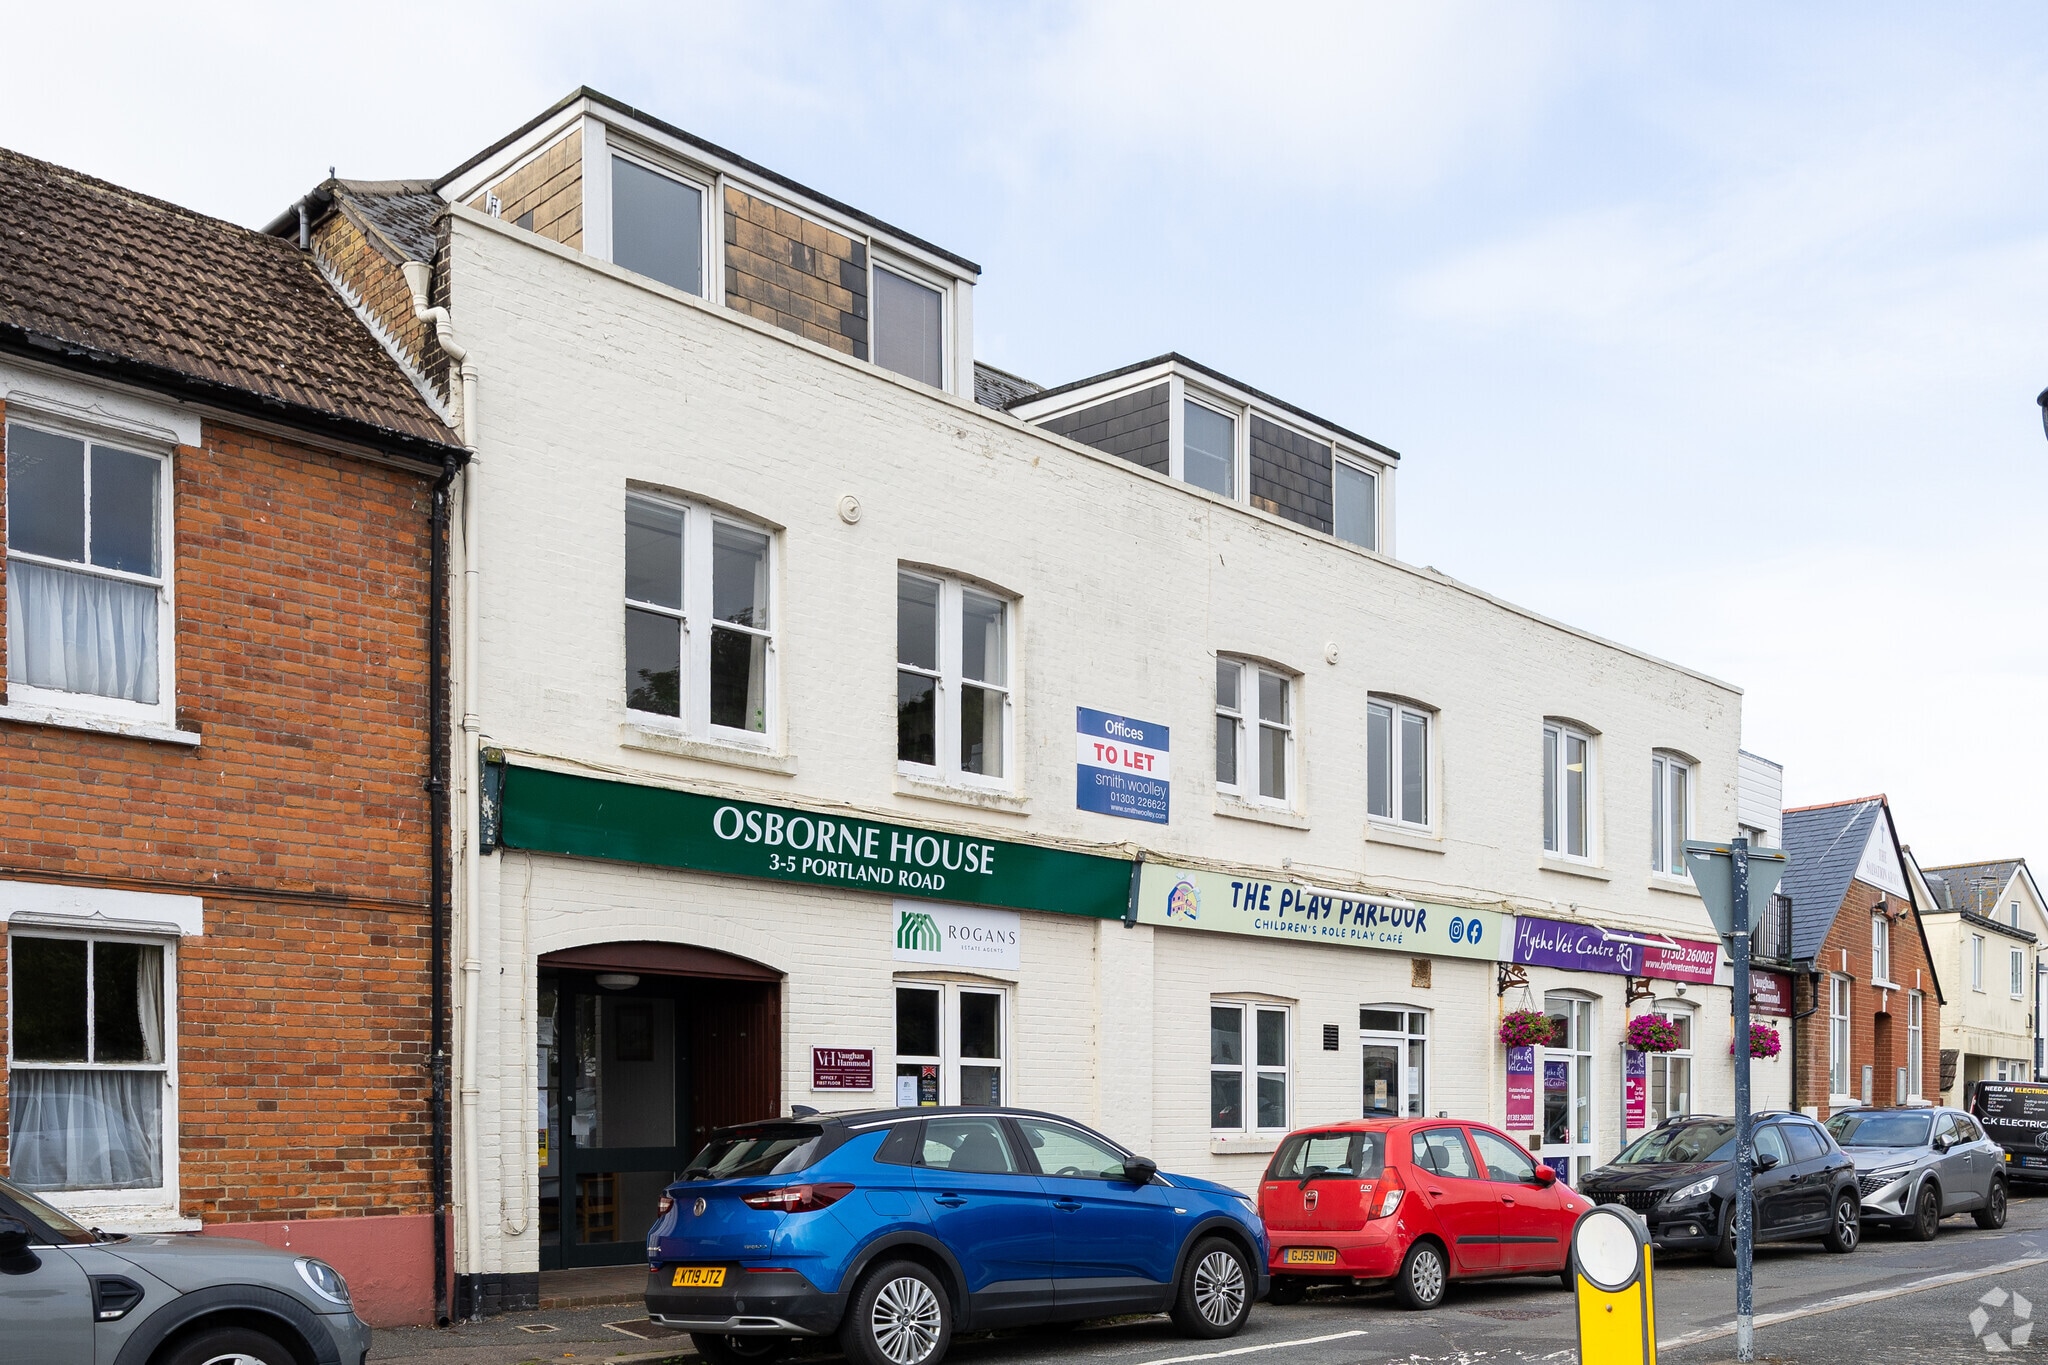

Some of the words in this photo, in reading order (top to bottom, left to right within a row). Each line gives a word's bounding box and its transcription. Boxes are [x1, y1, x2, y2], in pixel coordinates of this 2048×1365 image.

[1105, 720, 1144, 741] Offices
[1094, 743, 1118, 764] TO
[1123, 749, 1155, 772] LET
[1095, 773, 1125, 789] smith
[1127, 779, 1167, 800] woolley
[1110, 791, 1135, 805] 01303
[1137, 796, 1166, 811] 226622
[1110, 804, 1166, 820] www.smithwoolley.com
[713, 806, 880, 860] OSBORNE
[890, 831, 995, 875] HOUSE
[769, 854, 796, 873] 3-5
[801, 857, 893, 885] PORTLAND
[898, 870, 946, 891] ROAD
[1231, 881, 1272, 912] THE
[1279, 888, 1333, 921] PLAY
[1339, 900, 1427, 934] PARLOUR
[948, 925, 1016, 945] ROGANS
[1254, 918, 1317, 935] CHILDREN'S
[1322, 926, 1346, 938] ROLE
[1351, 929, 1375, 941] PLAY
[1379, 932, 1403, 944] CAFÉ
[1517, 918, 1553, 961] Hythe
[1555, 926, 1573, 954] Vet
[1575, 936, 1614, 957] Centre
[1661, 947, 1686, 961] 01303
[1686, 948, 1714, 965] 260003
[1645, 959, 1713, 976] www.hythevetcentre.co.uk
[1752, 974, 1776, 992] Vaughan
[837, 1051, 865, 1061] Vaughan
[837, 1059, 870, 1067] Hammond
[1981, 1116, 1998, 1126] C.K
[1291, 1250, 1315, 1261] GJ59
[1316, 1250, 1335, 1262] NWB
[679, 1269, 702, 1284] KT19
[701, 1269, 723, 1284] JTZ
